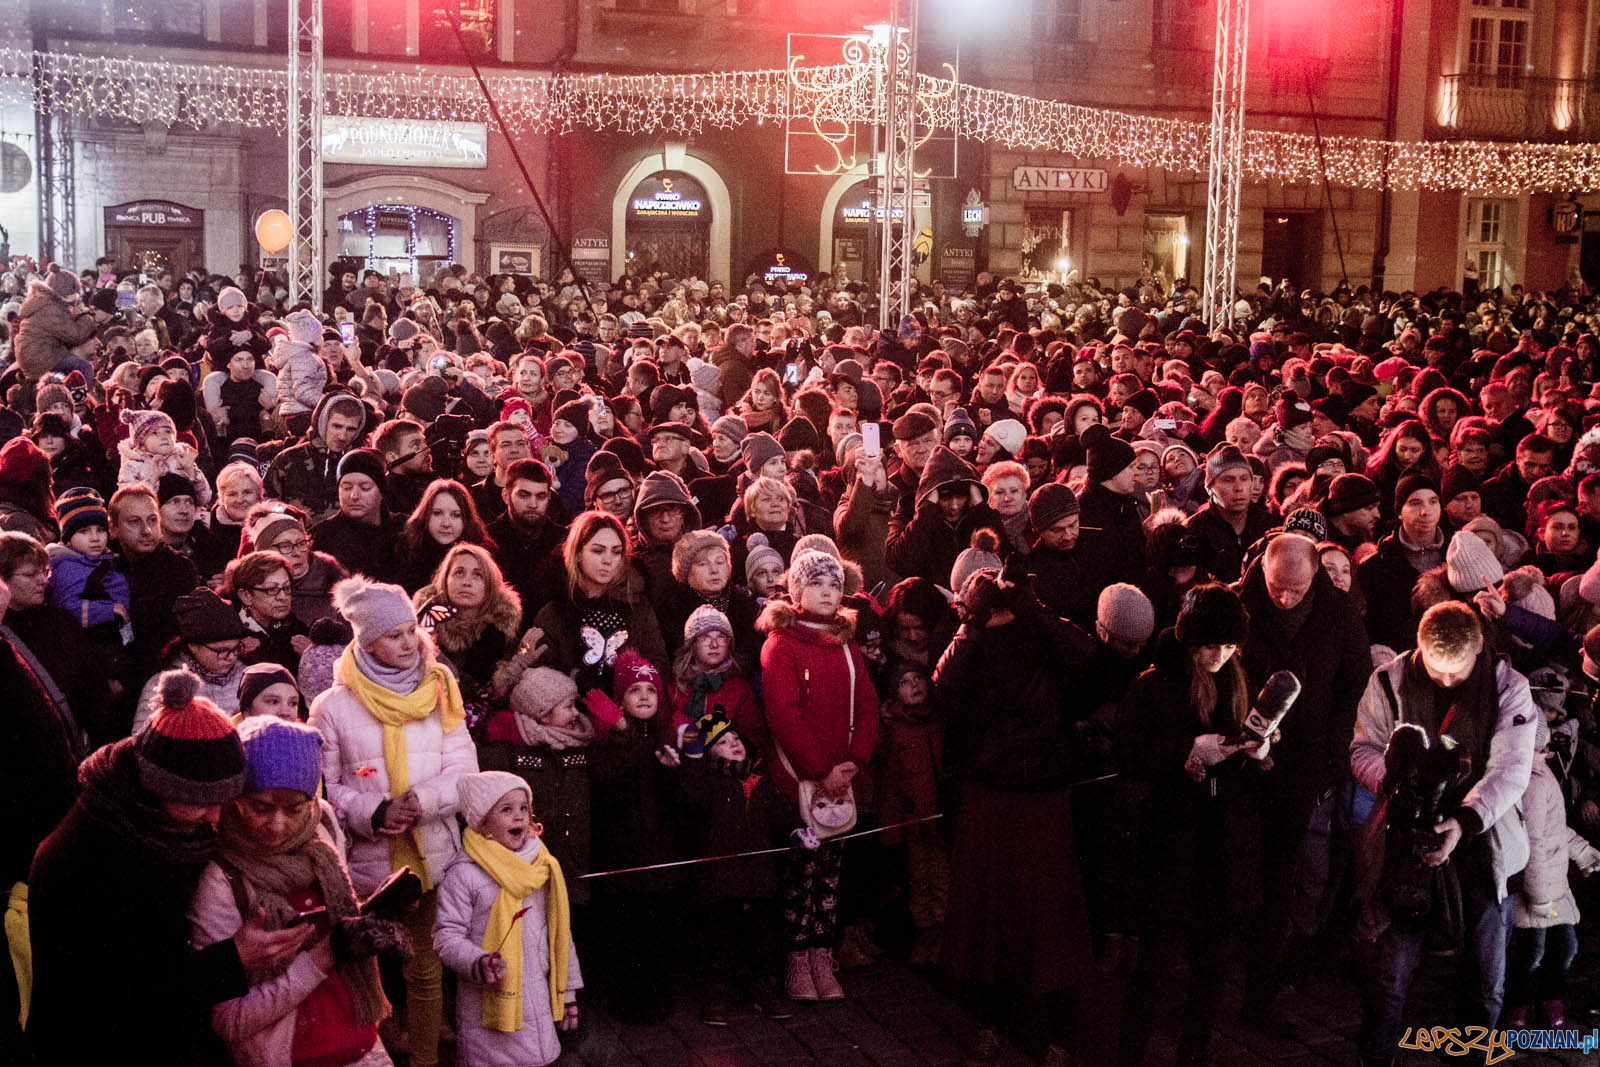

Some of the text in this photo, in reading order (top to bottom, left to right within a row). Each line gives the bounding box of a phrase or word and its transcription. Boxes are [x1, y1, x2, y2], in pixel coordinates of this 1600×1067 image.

[1019, 170, 1104, 189] ANTYKI
[634, 200, 701, 211] NAPRZECIWKO
[141, 212, 166, 224] PUB
[963, 209, 982, 222] LECH
[574, 238, 608, 247] ANTYKI
[943, 248, 973, 257] ANTYKI
